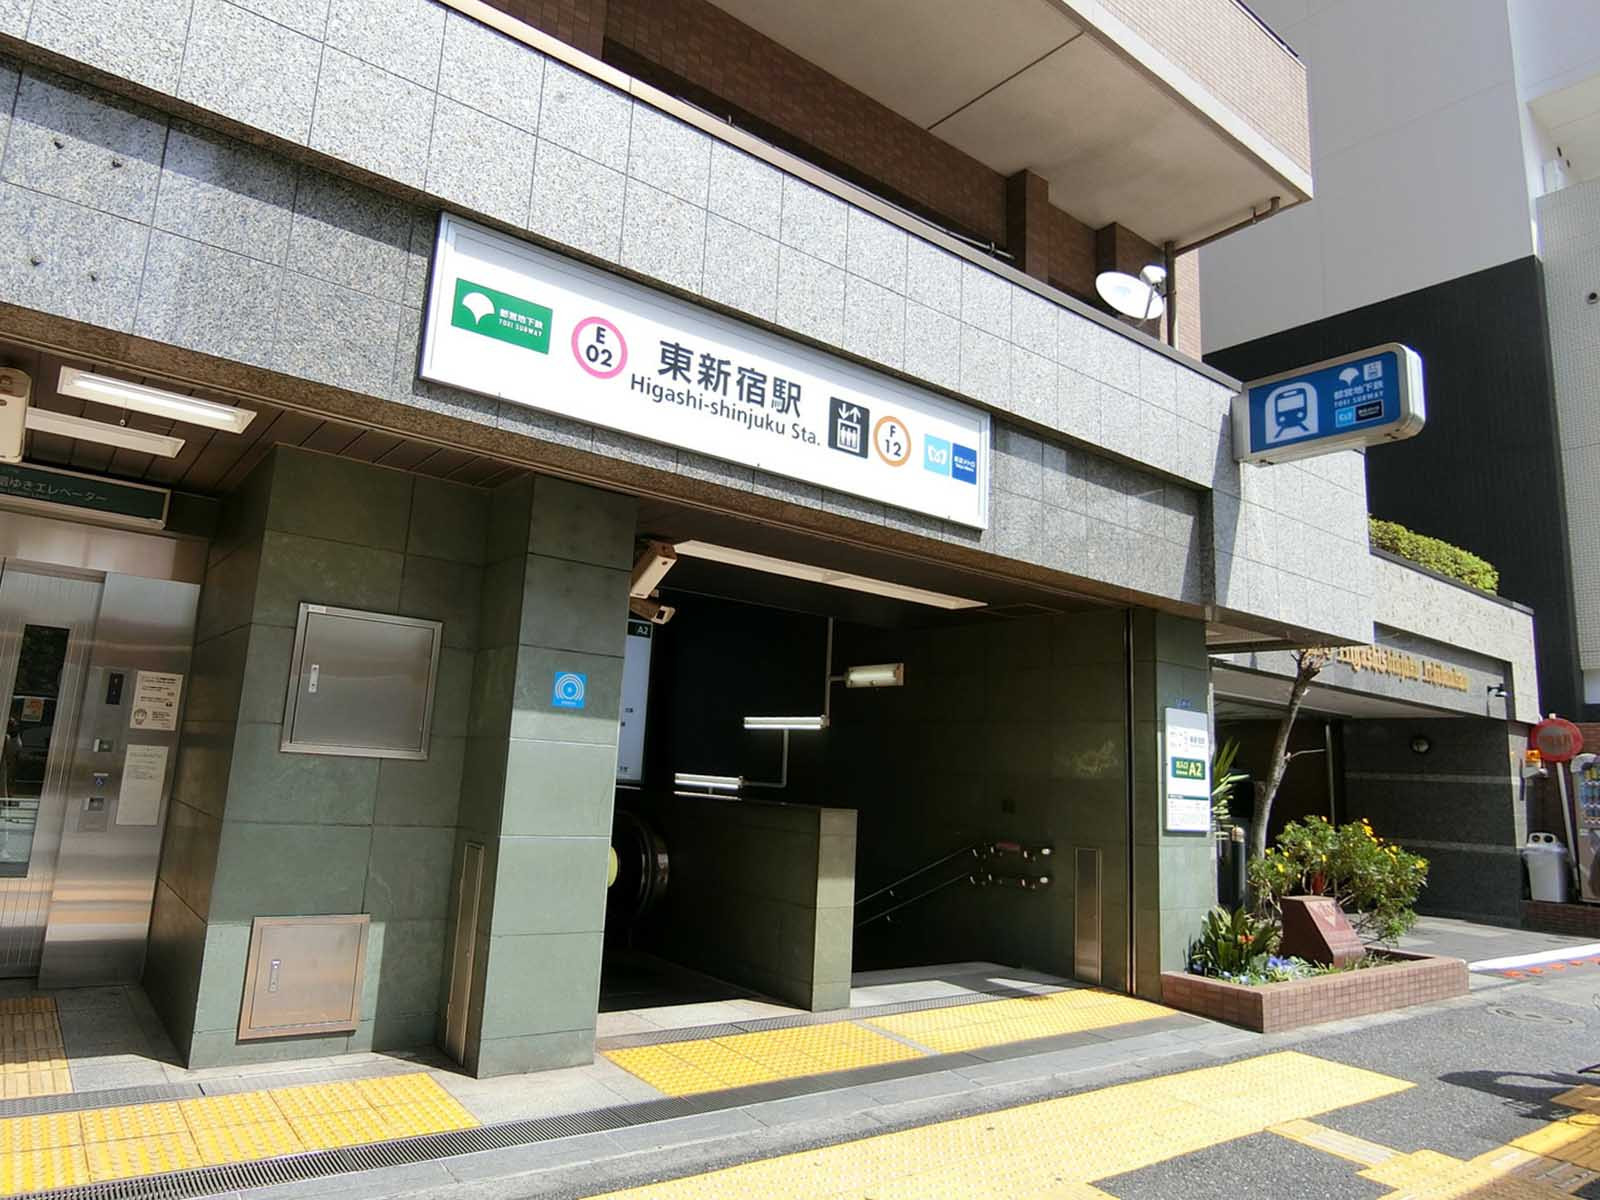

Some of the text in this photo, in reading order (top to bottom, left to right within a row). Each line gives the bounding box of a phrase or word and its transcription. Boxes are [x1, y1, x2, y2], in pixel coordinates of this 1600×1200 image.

[515, 322, 543, 337] SUBWAY
[596, 326, 606, 344] E
[586, 344, 613, 368] 02
[657, 340, 802, 418] 東新宿駅
[630, 373, 821, 446] Higashi-shinjuku Sta.
[889, 424, 897, 438] F
[884, 439, 902, 457] 12
[637, 625, 649, 636] A2
[1188, 761, 1203, 778] A2
